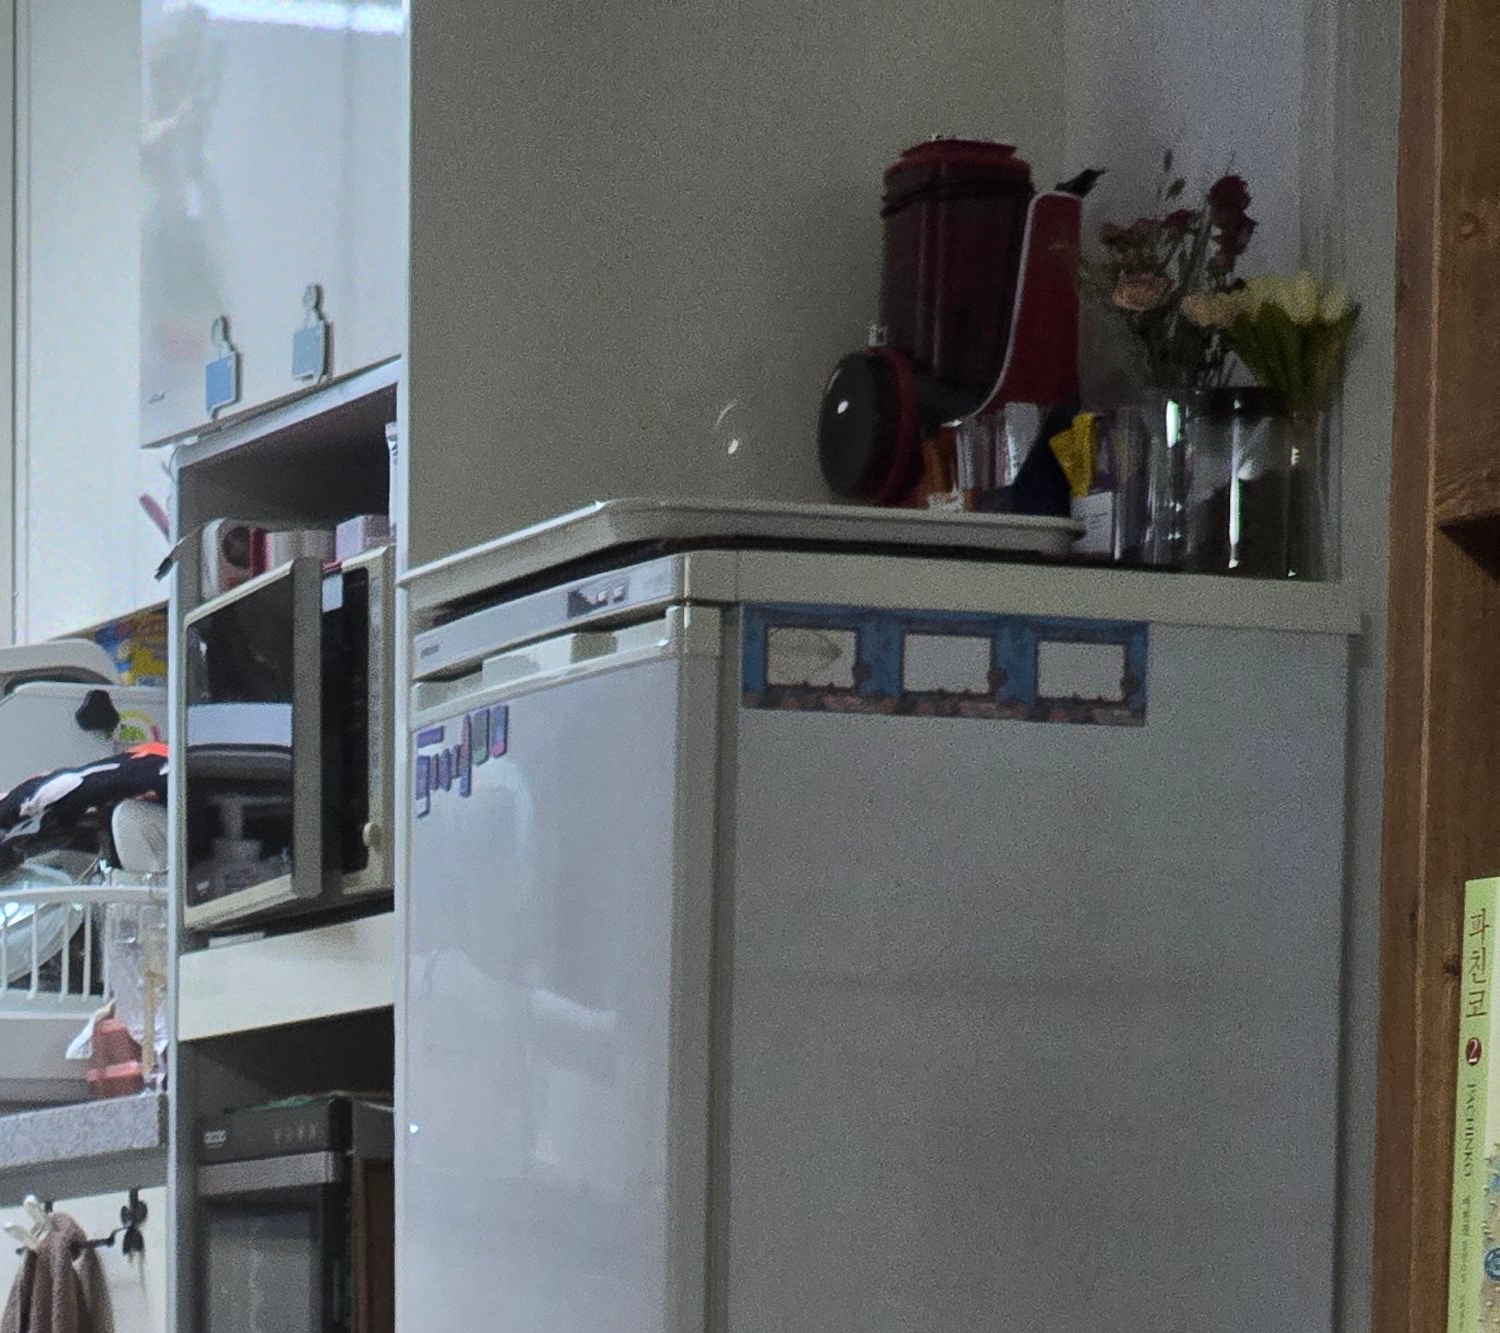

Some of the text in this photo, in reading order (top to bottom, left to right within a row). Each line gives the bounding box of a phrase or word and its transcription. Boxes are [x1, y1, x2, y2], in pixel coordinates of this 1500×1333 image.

[1466, 908, 1490, 1018] 파친코
[1469, 1039, 1478, 1063] 2
[1464, 1083, 1477, 1177] PACHINKO
